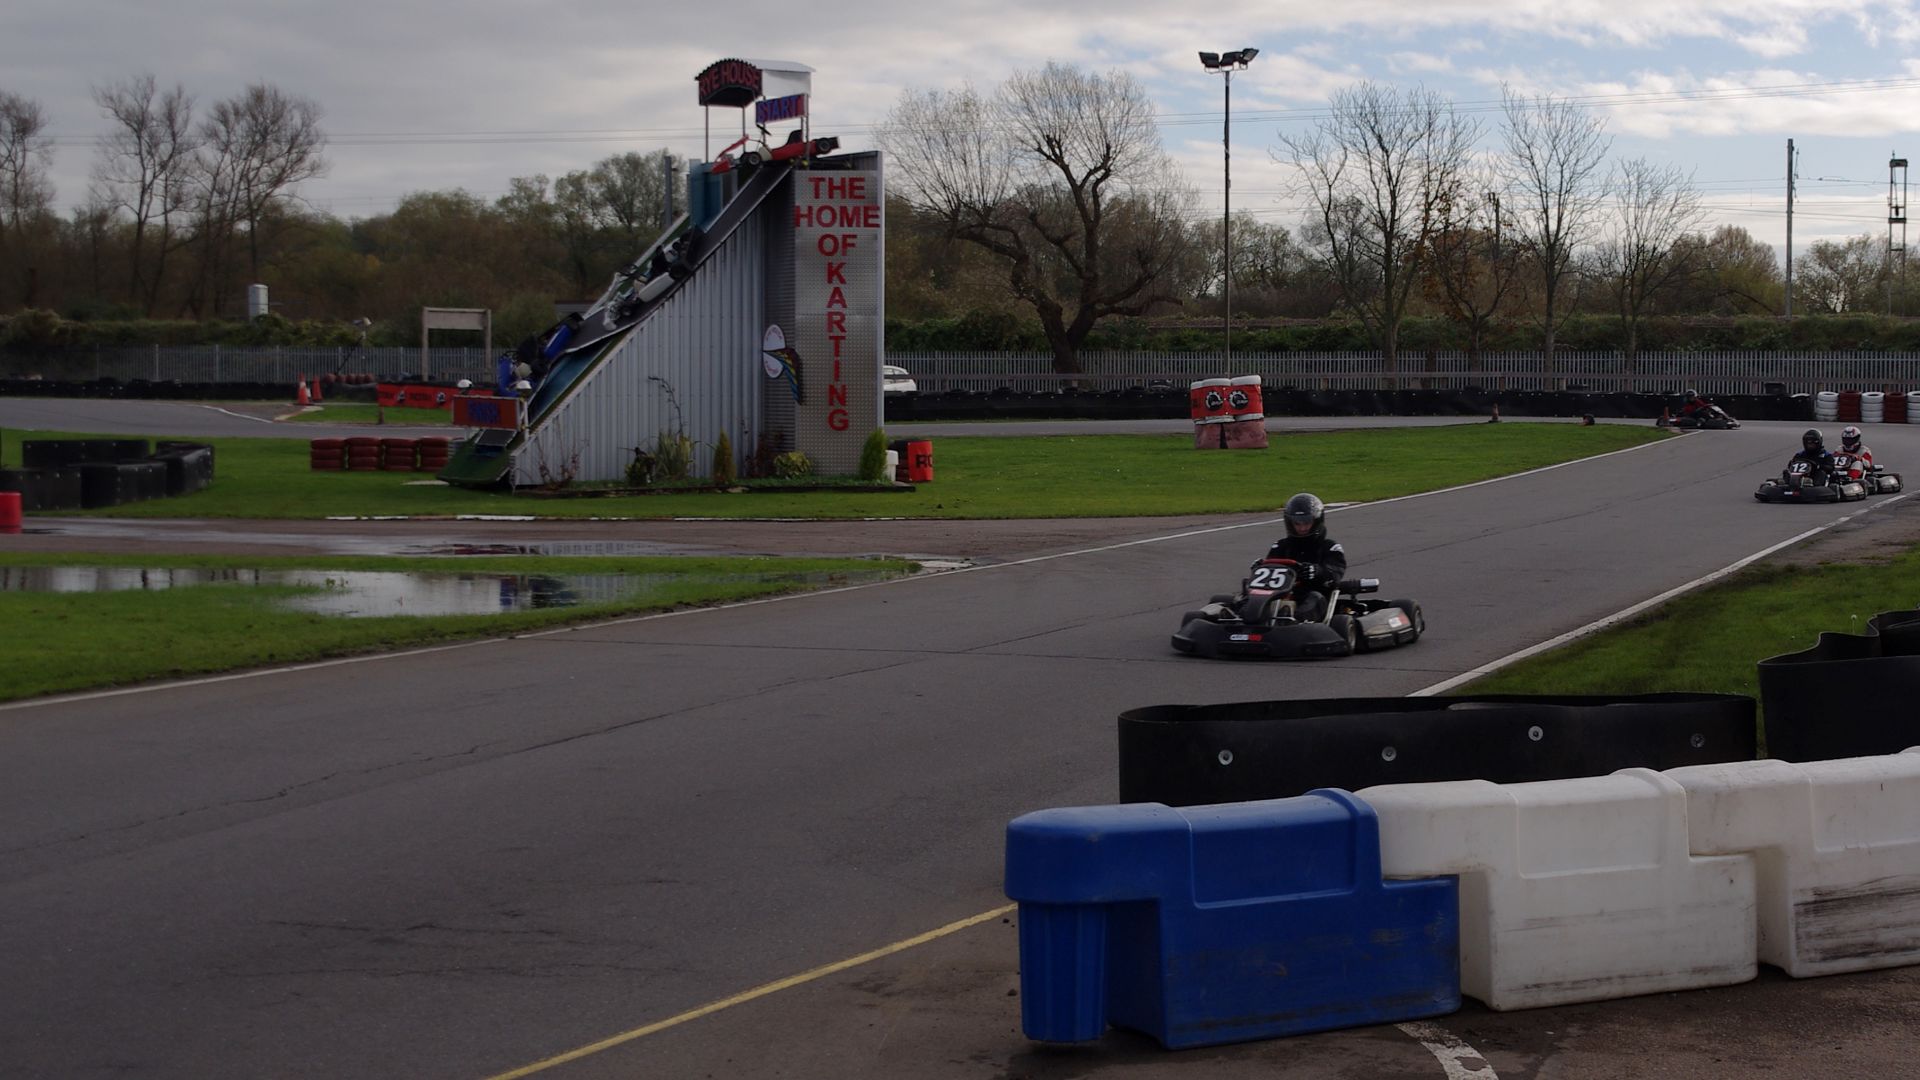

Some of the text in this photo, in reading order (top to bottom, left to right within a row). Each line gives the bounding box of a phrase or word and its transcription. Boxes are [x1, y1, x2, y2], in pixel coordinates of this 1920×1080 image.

[699, 61, 760, 94] RYE HOUSE
[808, 176, 866, 200] THE
[793, 204, 881, 228] HOME
[817, 233, 858, 257] OF
[826, 262, 849, 431] KARTING
[1792, 463, 1808, 473] 12
[1833, 456, 1847, 466] 13
[1250, 568, 1288, 588] 25
